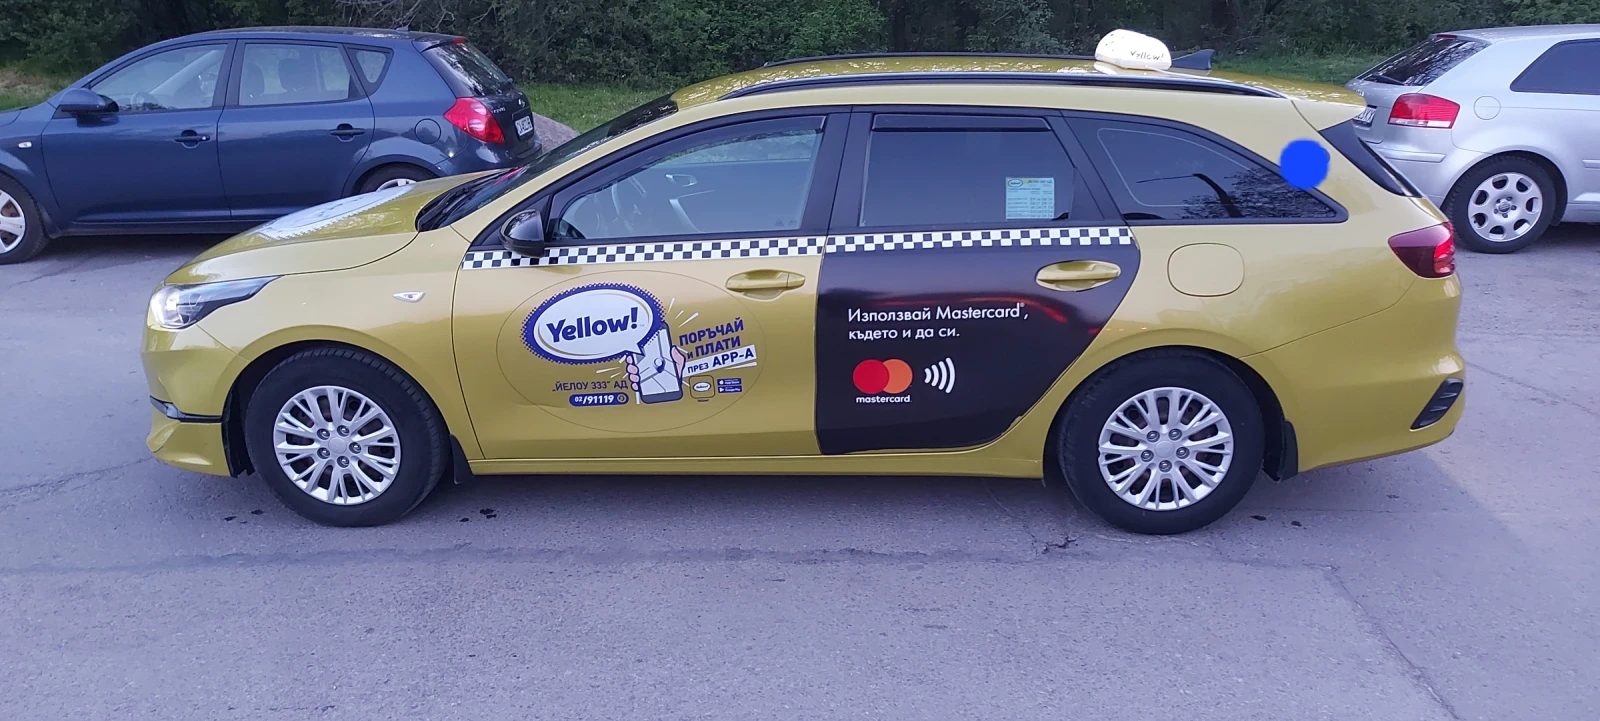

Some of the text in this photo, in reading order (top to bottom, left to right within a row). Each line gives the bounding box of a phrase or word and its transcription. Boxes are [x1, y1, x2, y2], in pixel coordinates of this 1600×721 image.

[848, 306, 931, 322] Използвай
[546, 307, 638, 343] Yellow!
[679, 317, 744, 346] ПОРЪЧАЙ
[848, 327, 960, 341] където и да си.
[687, 336, 741, 360] и ПЛАТИ
[687, 362, 709, 374] ПРЕЗ
[614, 380, 628, 390] АД
[574, 395, 614, 404] 02/91119
